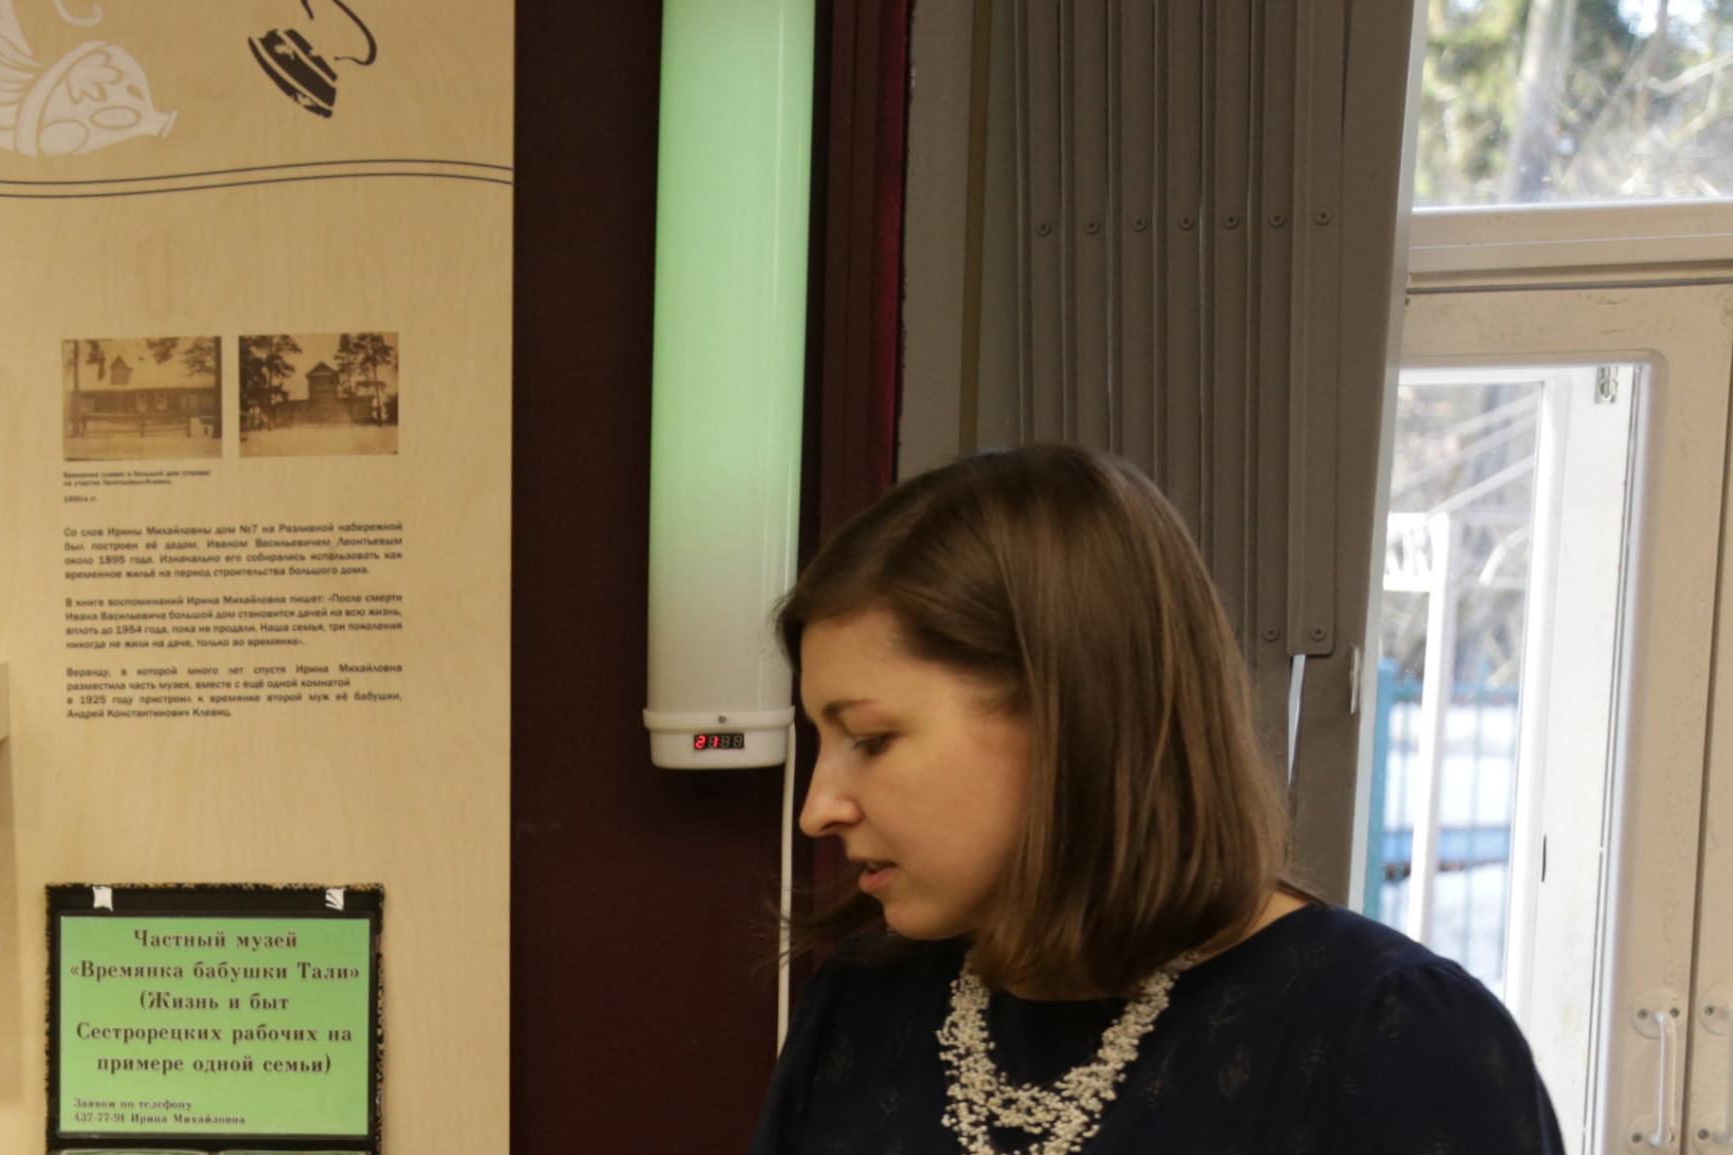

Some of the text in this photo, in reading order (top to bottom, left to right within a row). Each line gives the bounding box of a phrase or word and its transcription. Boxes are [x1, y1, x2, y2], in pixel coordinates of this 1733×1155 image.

[134, 929, 297, 952] Частный музей
[70, 961, 359, 981] «Времянка бабушки Тали»
[140, 990, 290, 1011] (Жизнь и быт
[76, 1022, 352, 1045] Сестрорецких рабочих на
[97, 1054, 331, 1076] примере одной семьи)
